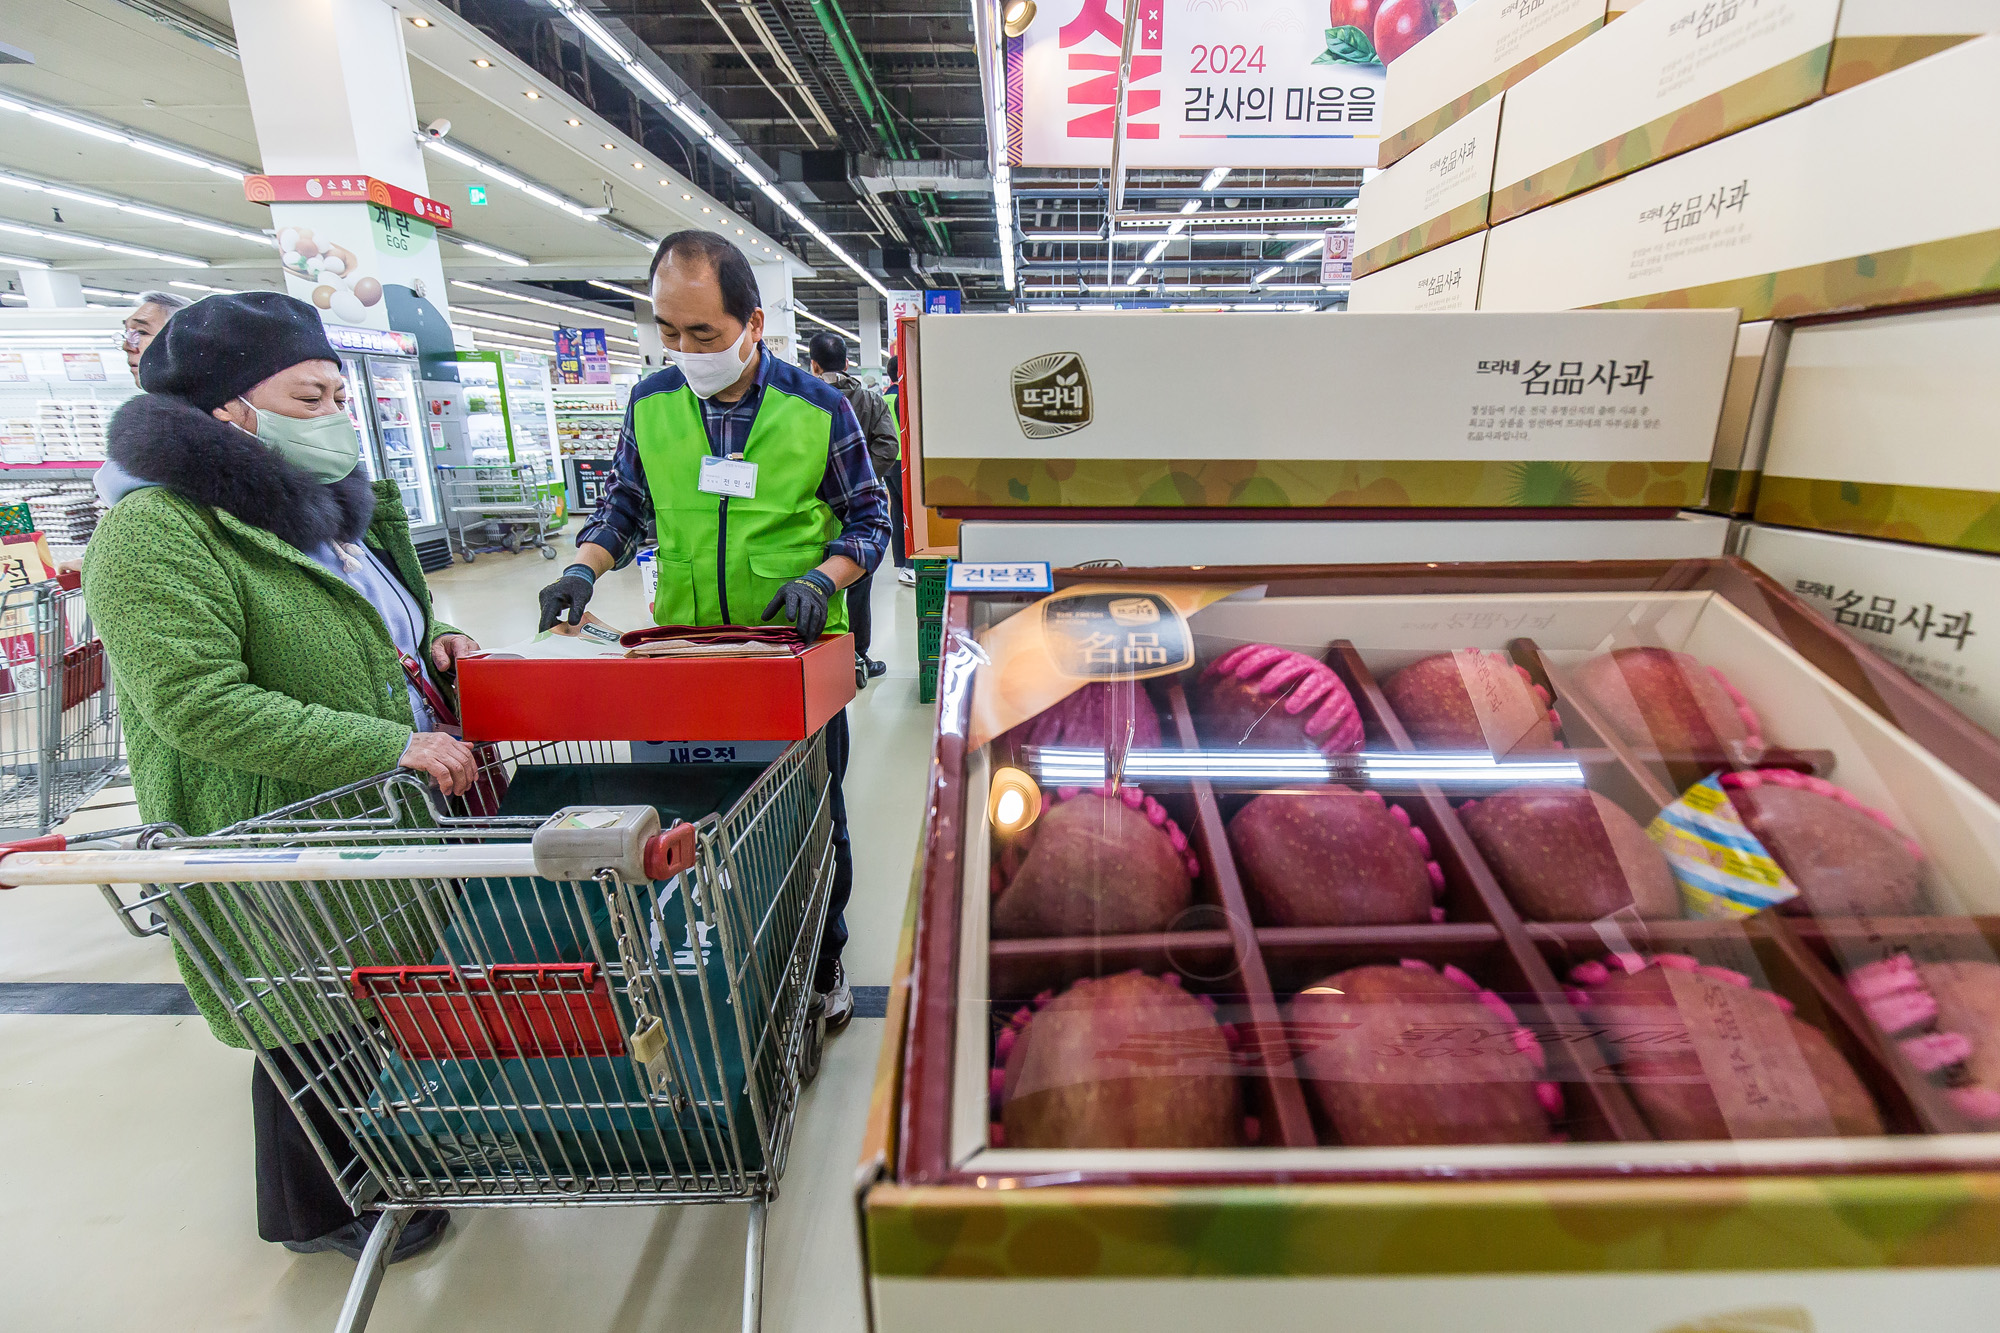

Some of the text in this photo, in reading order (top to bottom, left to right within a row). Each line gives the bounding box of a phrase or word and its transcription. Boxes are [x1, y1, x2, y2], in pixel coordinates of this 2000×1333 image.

[1189, 44, 1267, 74] 2024
[1184, 86, 1377, 124] 감사의 마음을
[373, 205, 411, 239] 계란
[1662, 178, 1751, 234] 名品사과
[386, 234, 409, 251] EGG
[1476, 359, 1655, 396] 뜨라네 名品사과
[1021, 385, 1084, 409] 뜨라네
[962, 567, 1037, 583] 견본품
[1831, 588, 1977, 652] 名品사과
[1077, 630, 1168, 666] 名品
